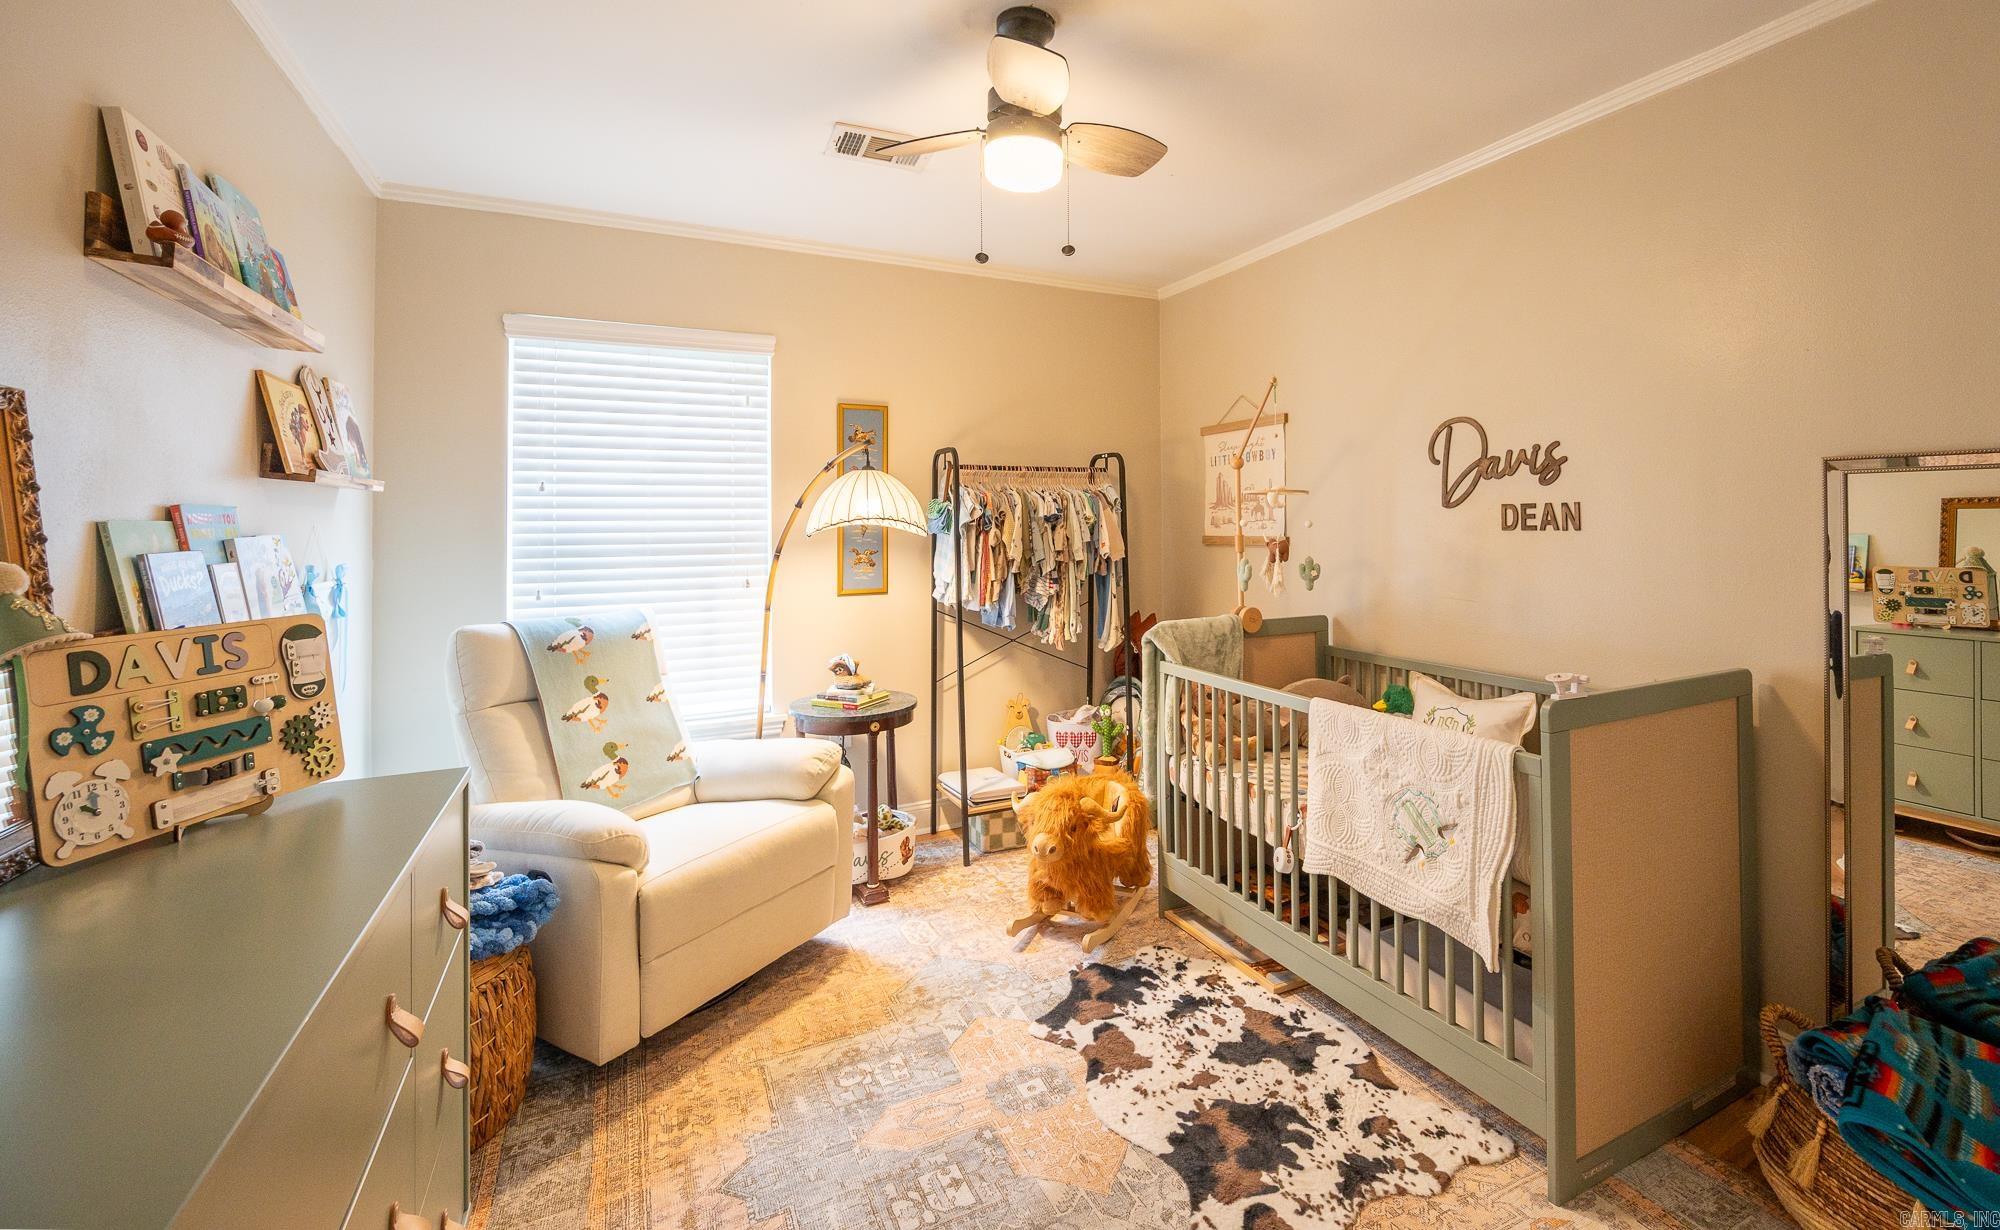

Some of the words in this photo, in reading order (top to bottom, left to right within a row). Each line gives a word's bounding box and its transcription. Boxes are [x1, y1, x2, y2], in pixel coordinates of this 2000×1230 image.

[1244, 448, 1275, 463] OWBOY
[1428, 416, 1568, 509] Davis
[1501, 501, 1582, 532] DEAN
[66, 631, 249, 697] DAVIS
[72, 790, 81, 800] 11
[87, 783, 97, 793] 12
[62, 802, 73, 811] 10
